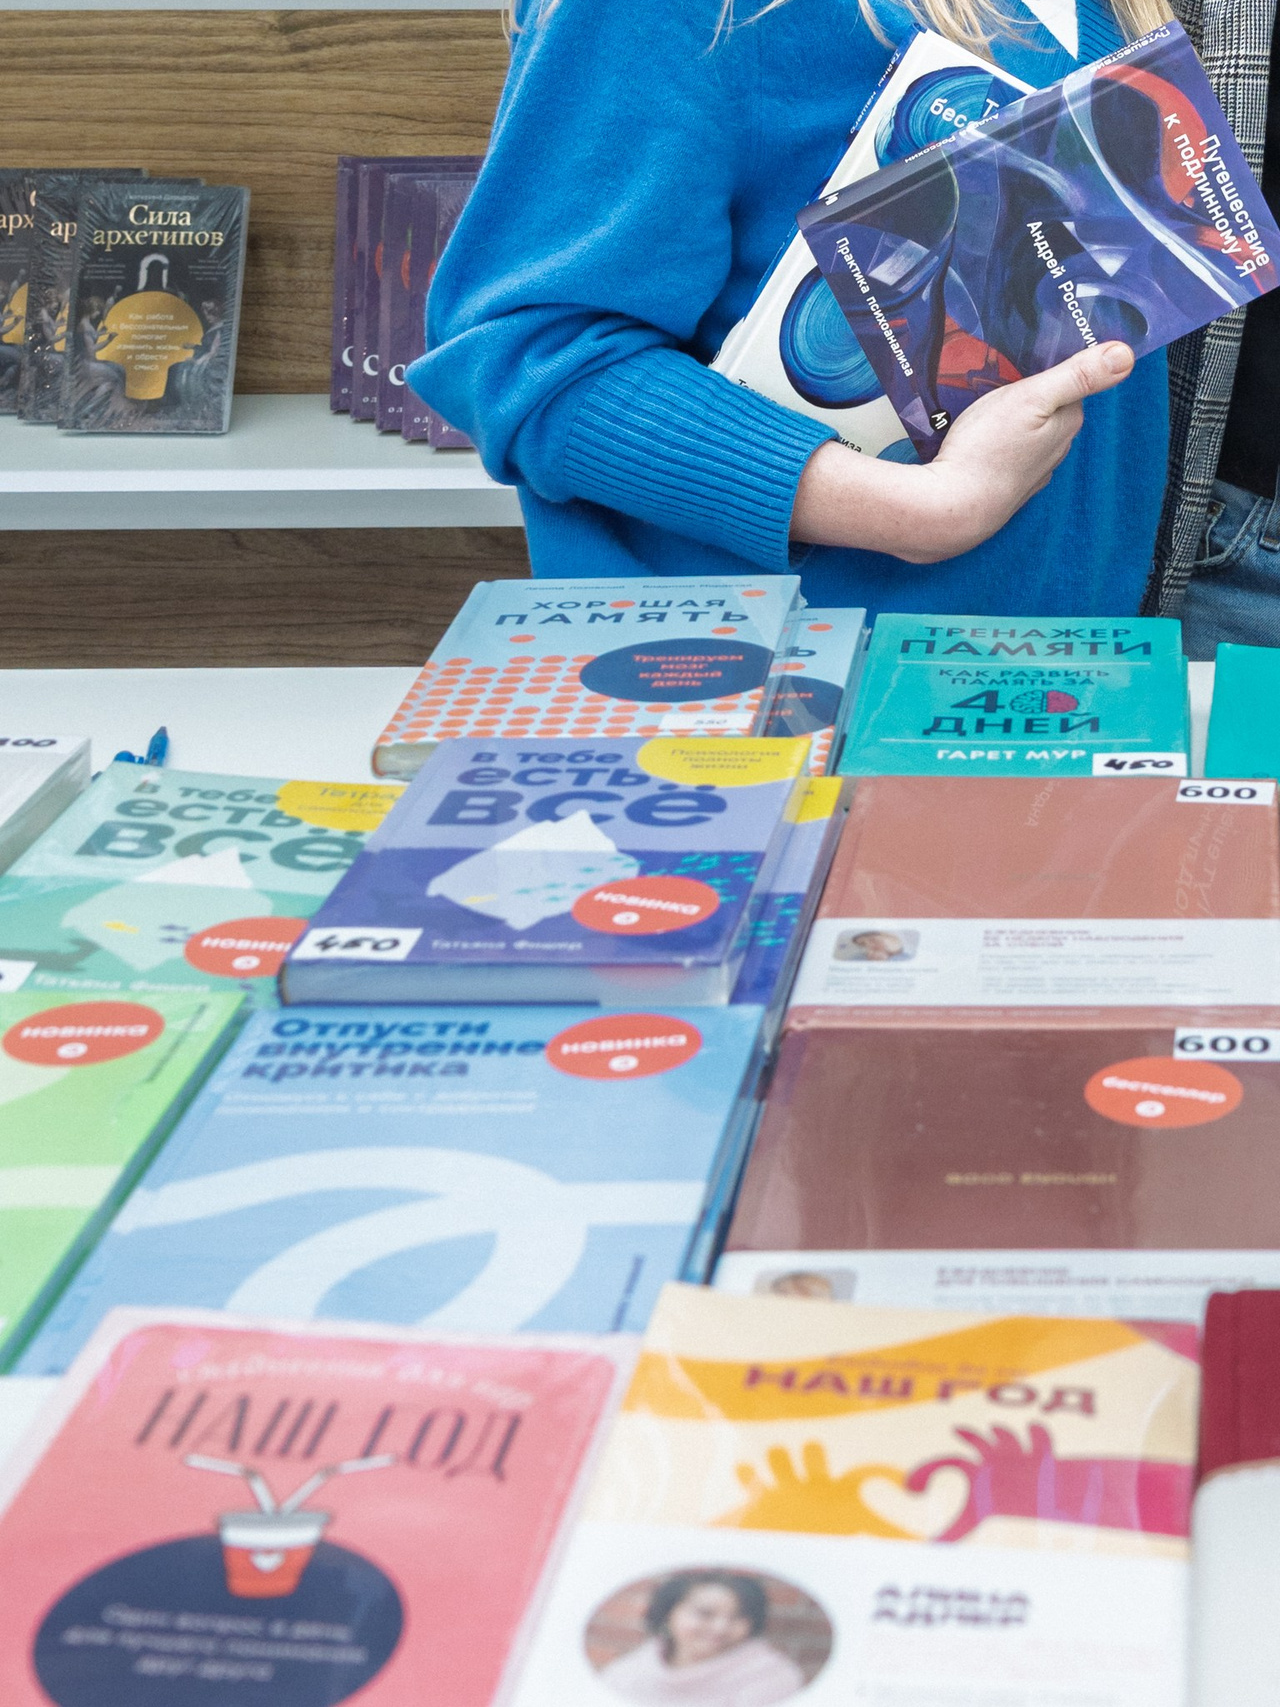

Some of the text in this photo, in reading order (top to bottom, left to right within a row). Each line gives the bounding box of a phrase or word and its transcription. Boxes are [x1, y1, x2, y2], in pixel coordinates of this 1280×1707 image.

[1089, 27, 1171, 73] Путешествие
[850, 48, 901, 134] Тайны нашего
[904, 135, 956, 164] Россохин
[1173, 133, 1242, 255] подлинному
[1235, 259, 1257, 278] Я
[1199, 134, 1270, 267] Путешествие
[129, 204, 191, 226] Сила
[93, 229, 224, 251] архетипов
[1026, 220, 1066, 279] Андрей
[835, 236, 914, 378] Практика психоанализа
[495, 610, 749, 625] ПАМЯТЬ
[925, 626, 1131, 638] ТРЕНАЖЕР
[900, 639, 1152, 656] ПАМЯТИ
[939, 669, 1110, 678] КАК РАЗВИТЬ
[950, 677, 1095, 686] ПАМЯТЬ ЗА
[922, 710, 1100, 736] ДНЕЙ
[937, 749, 1086, 760] ГАРЕТ МУР
[456, 766, 651, 786] есть
[1179, 785, 1257, 799] 600
[271, 1018, 490, 1043] Отпусти
[255, 1040, 545, 1061] внутренне
[1177, 1035, 1272, 1053] 600
[240, 1061, 470, 1084] критика
[743, 1365, 914, 1401] НАШ
[939, 1381, 1098, 1417] ГОД
